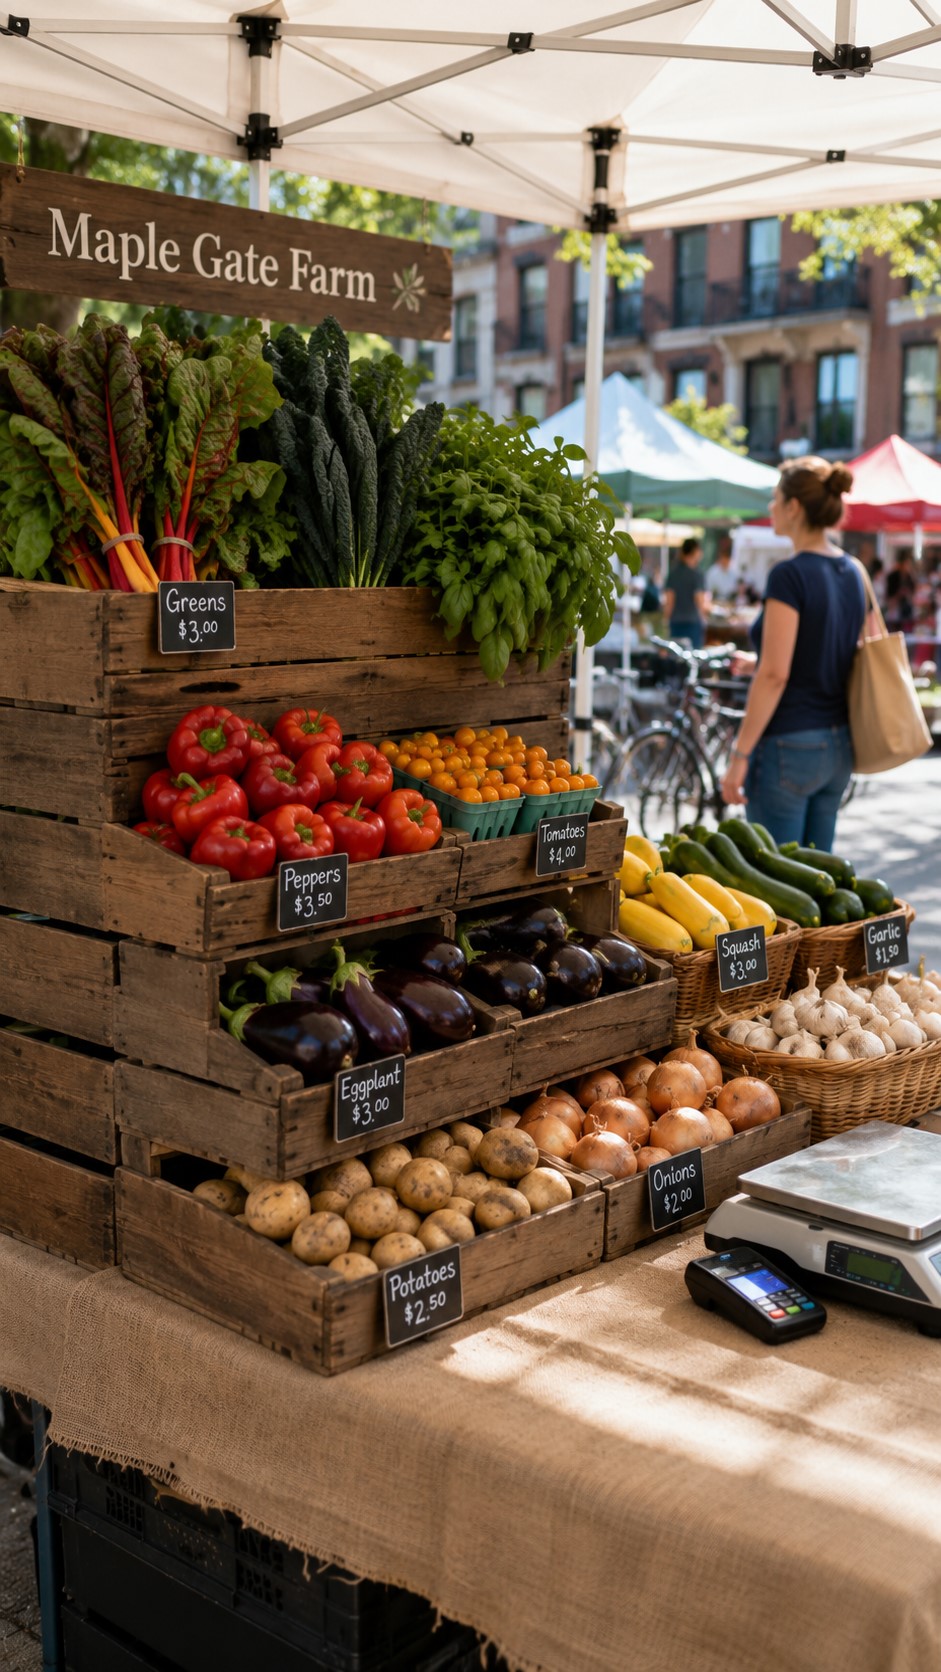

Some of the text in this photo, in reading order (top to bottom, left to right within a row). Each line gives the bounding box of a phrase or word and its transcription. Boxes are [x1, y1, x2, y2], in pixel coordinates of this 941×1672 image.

[47, 206, 377, 303] Maple Gate Farm
[166, 588, 226, 613] Greens
[541, 822, 585, 843] Tomatoes
[549, 845, 576, 866] $4.00
[284, 867, 341, 894] Peppers
[294, 892, 333, 917] $3.50
[722, 932, 761, 960] Squash
[867, 923, 901, 944] Garlic
[875, 944, 899, 964] $1.50
[730, 958, 757, 980] $3.00
[341, 1063, 401, 1102] Eggplant
[352, 1096, 390, 1125] $3.00
[653, 1163, 696, 1191] Onions
[663, 1187, 692, 1214] $2.00
[389, 1262, 456, 1302] Potatoes
[404, 1291, 446, 1326] $2.50
